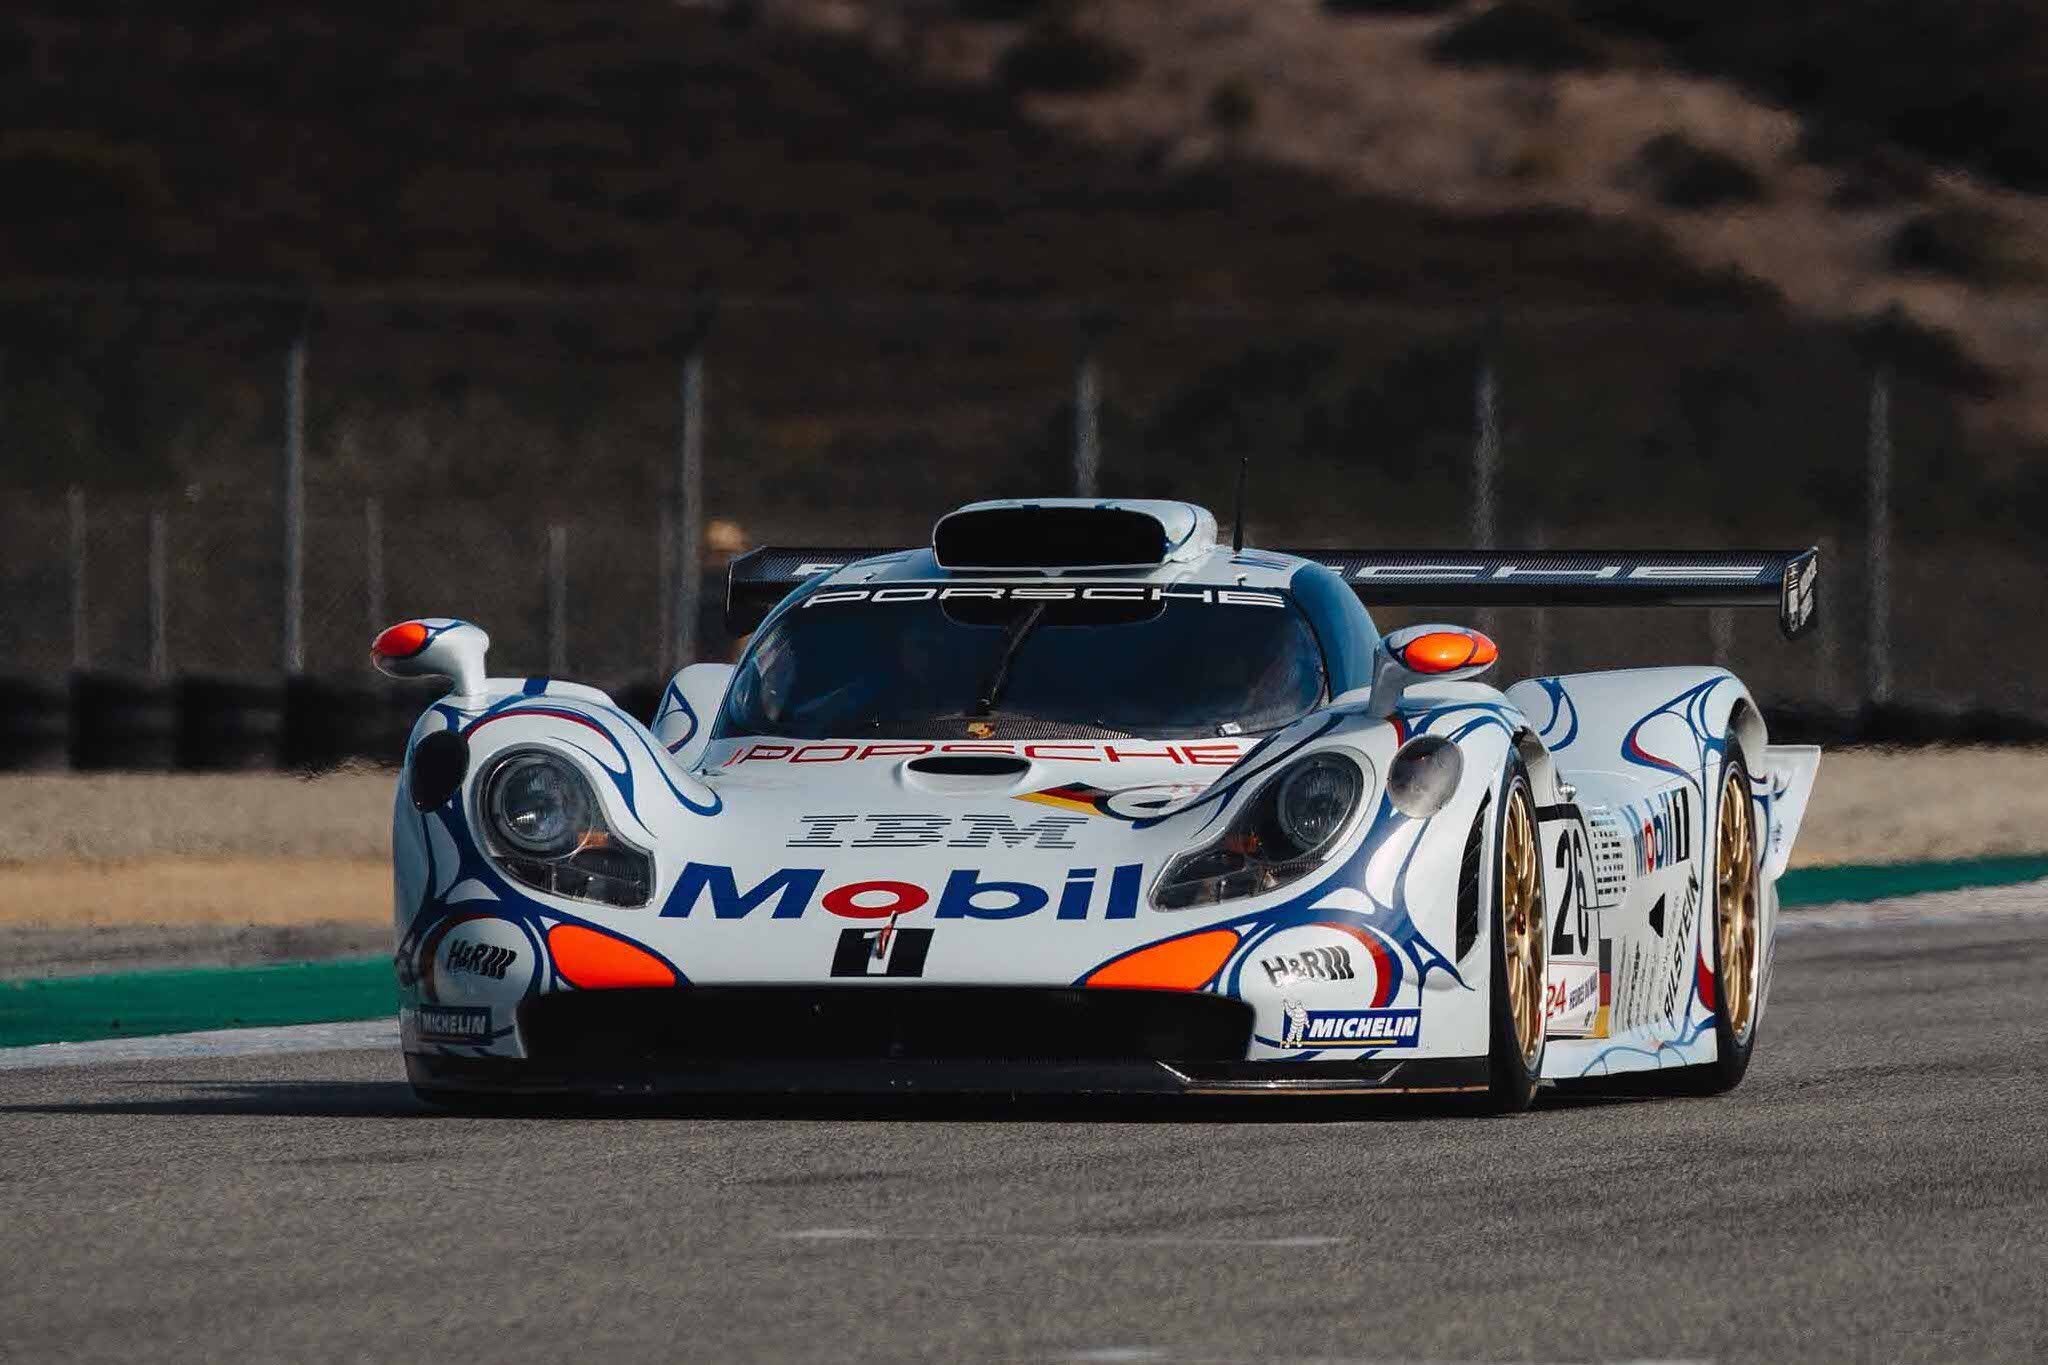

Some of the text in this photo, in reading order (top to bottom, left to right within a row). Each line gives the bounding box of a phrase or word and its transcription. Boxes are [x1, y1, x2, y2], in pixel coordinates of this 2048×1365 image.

[803, 587, 1285, 608] PORSCHE
[786, 815, 1089, 849] IBM
[659, 862, 1144, 919] Mobil
[1551, 829, 1591, 957] 26
[1664, 864, 1699, 1030] BILSTEIN
[1546, 978, 1567, 1018] 24
[421, 1013, 487, 1035] MICHELIN
[1309, 1016, 1418, 1038] MICHELIN
